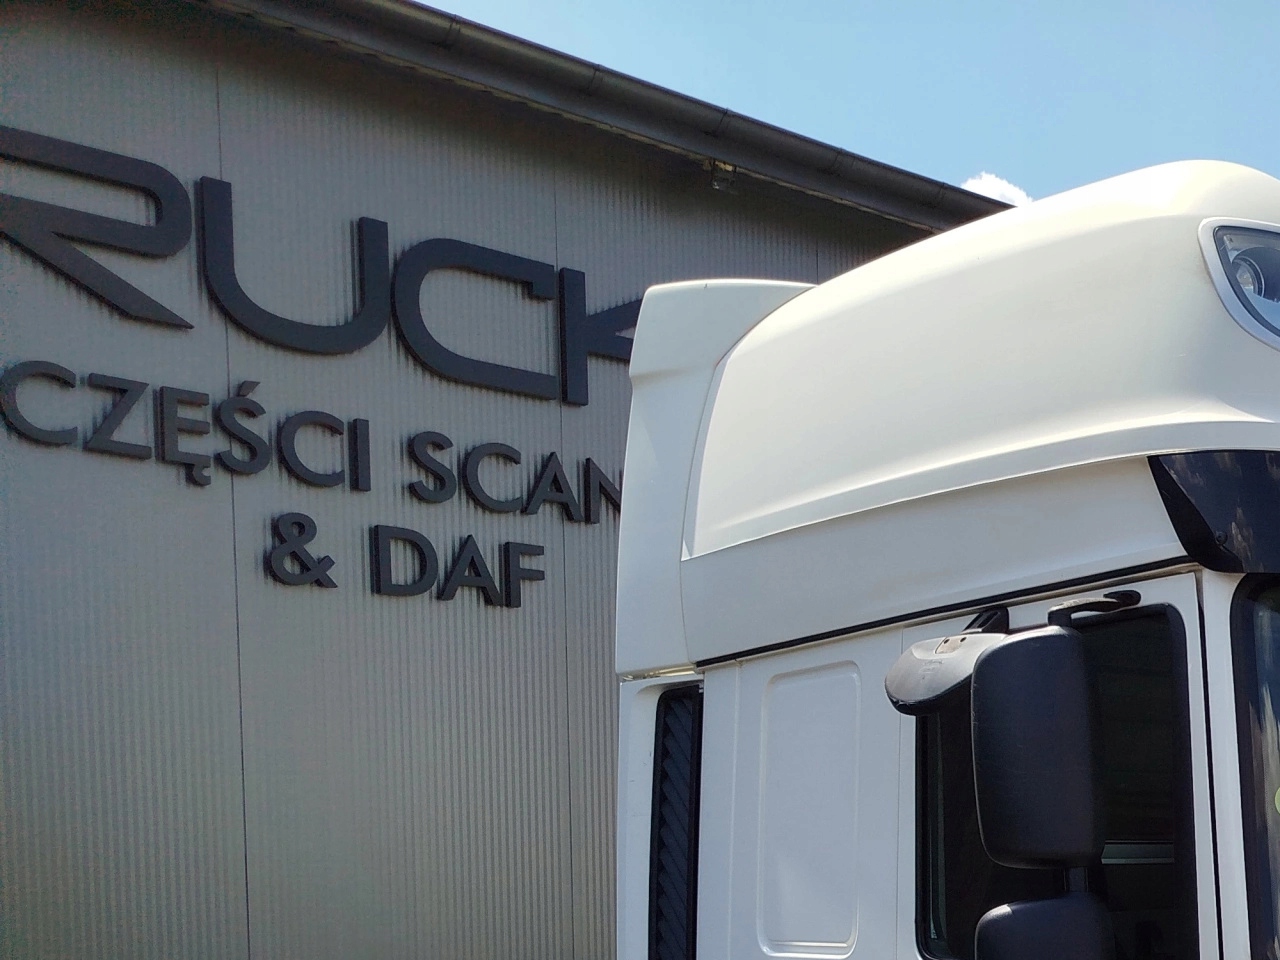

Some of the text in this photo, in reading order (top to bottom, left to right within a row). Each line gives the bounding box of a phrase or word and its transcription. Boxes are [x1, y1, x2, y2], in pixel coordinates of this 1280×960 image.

[2, 360, 623, 524] CZĘŚCI SCAN
[266, 512, 545, 608] & DAF
